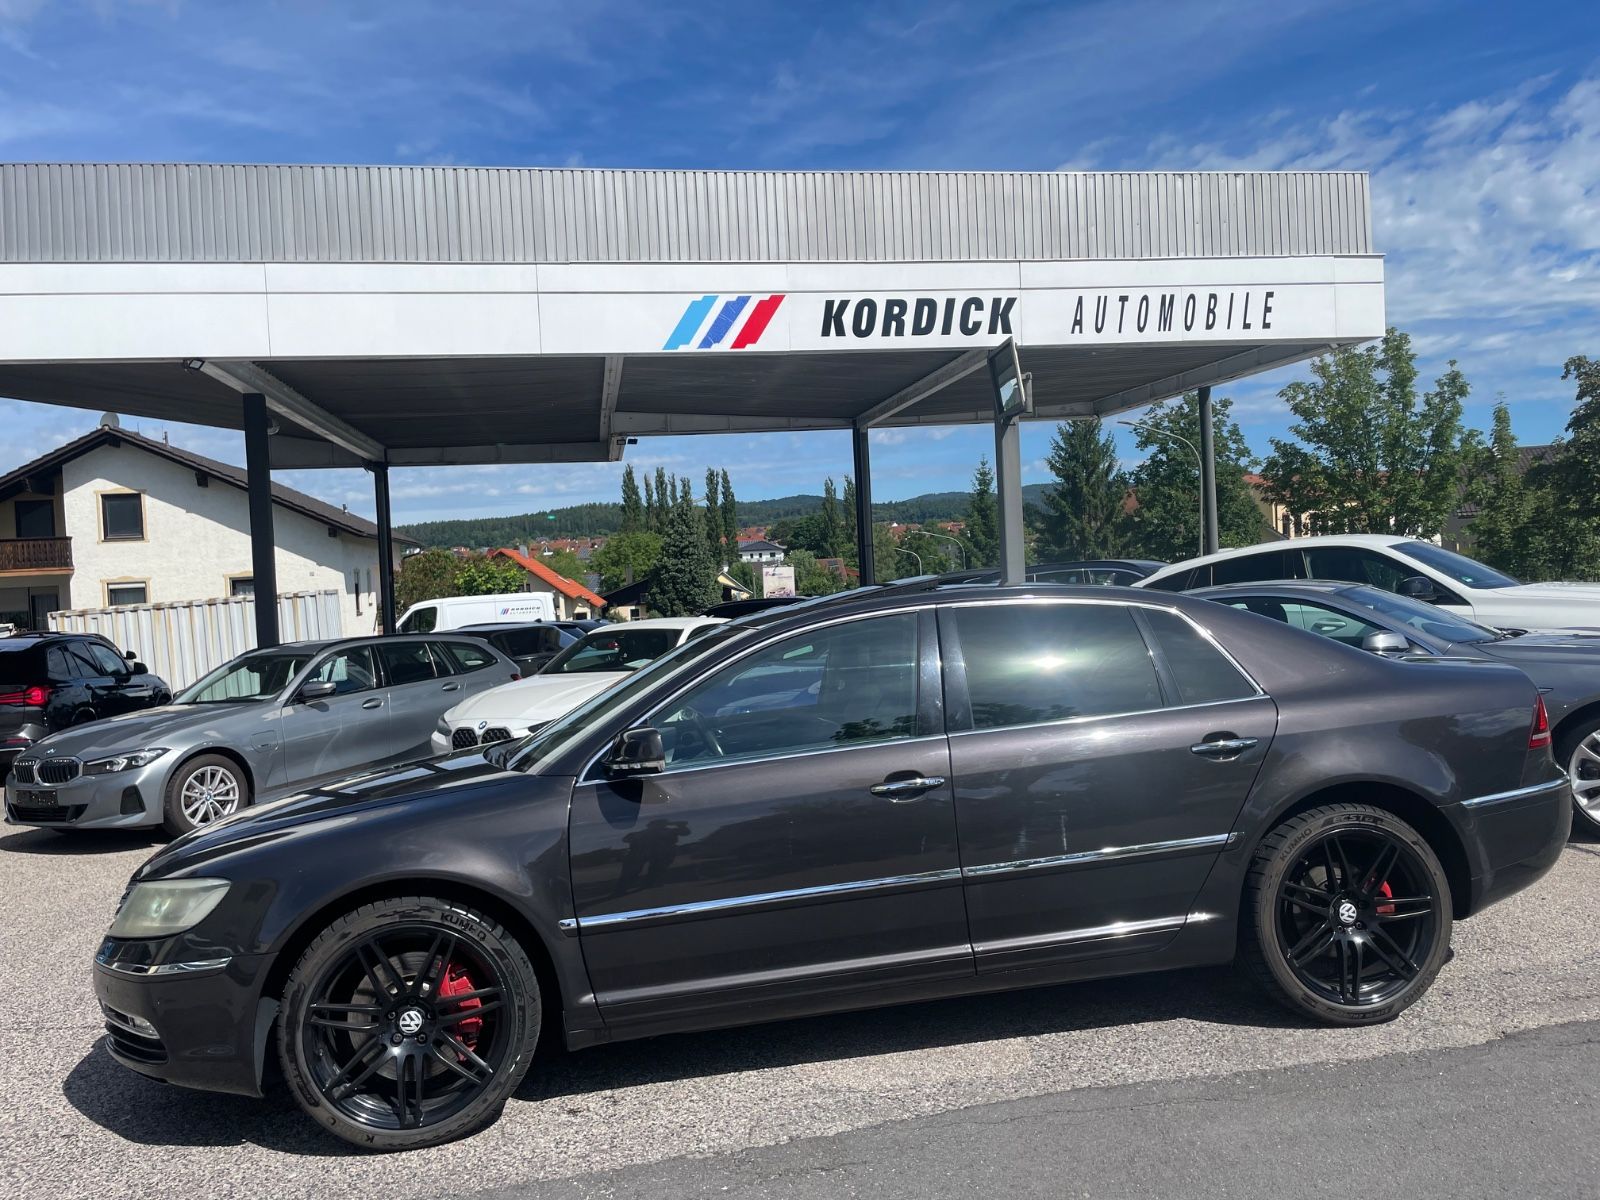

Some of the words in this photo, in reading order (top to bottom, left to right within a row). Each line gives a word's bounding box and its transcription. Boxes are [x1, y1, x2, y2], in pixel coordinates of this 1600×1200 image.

[821, 297, 1017, 338] KORDICK
[1071, 291, 1275, 334] AUTOMOBILE
[1280, 828, 1313, 861] KUMHO
